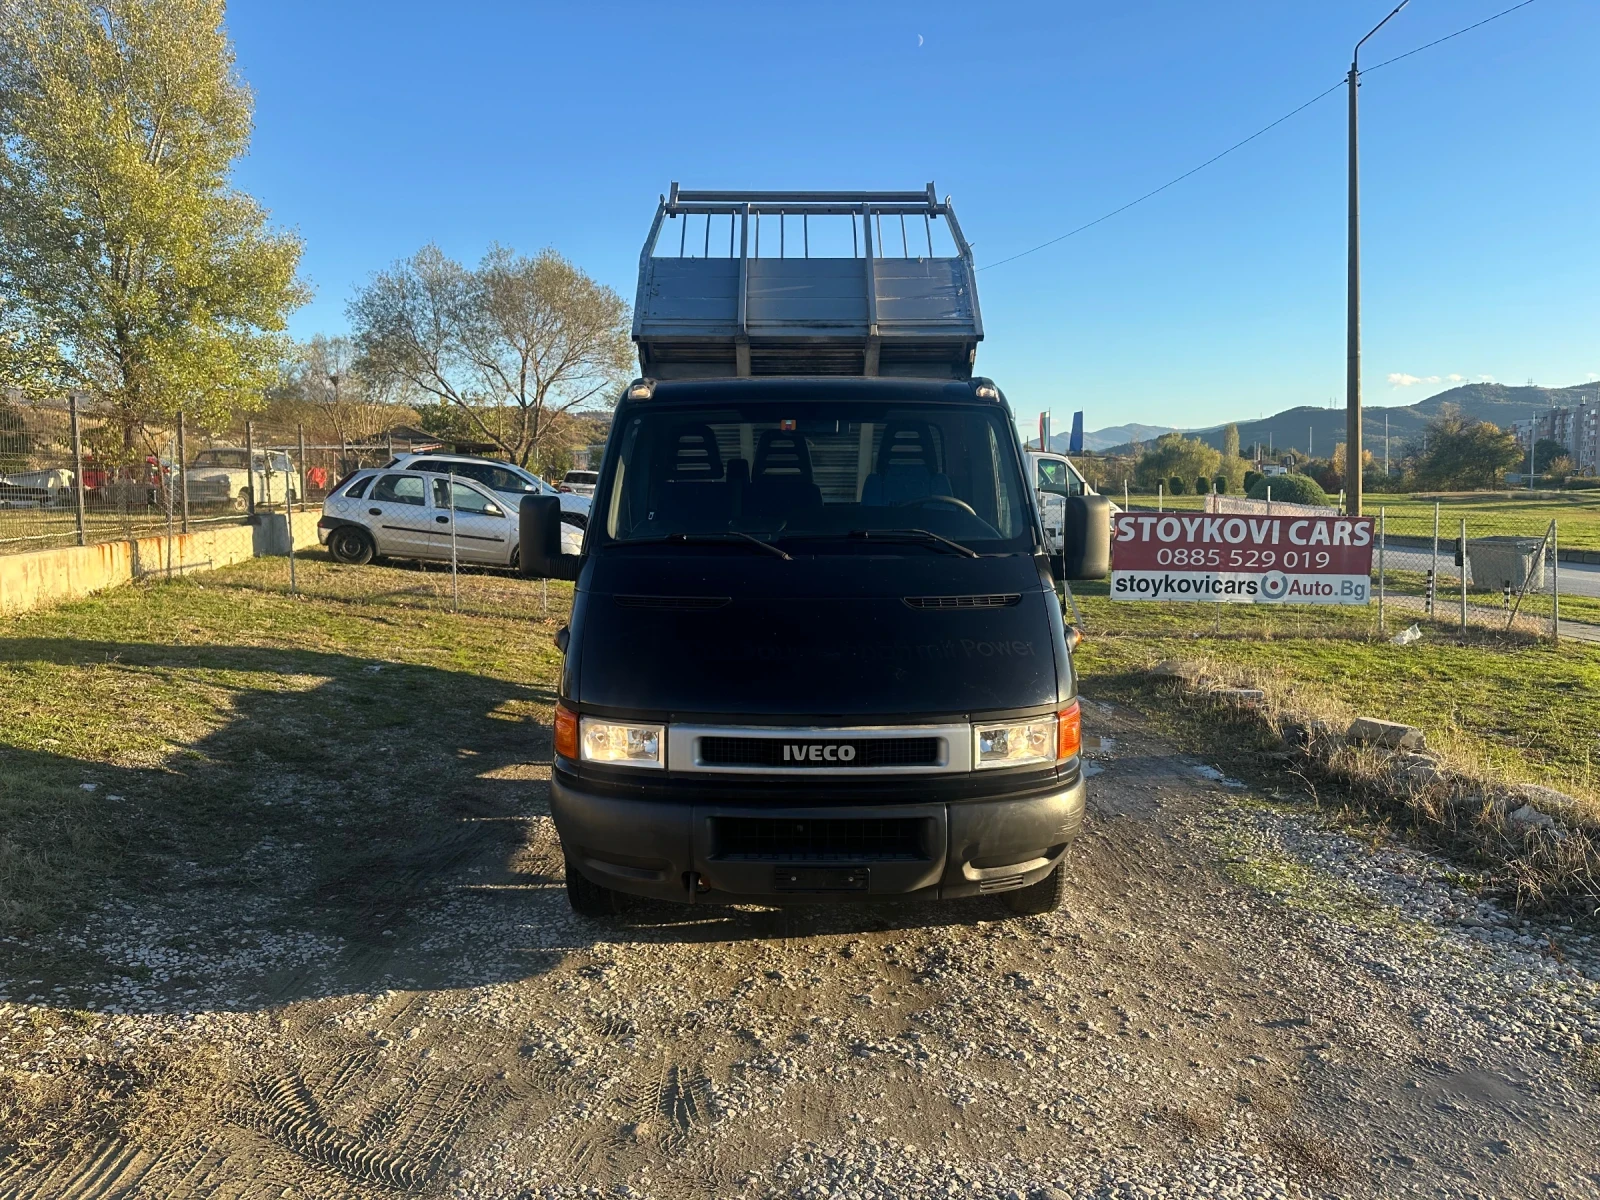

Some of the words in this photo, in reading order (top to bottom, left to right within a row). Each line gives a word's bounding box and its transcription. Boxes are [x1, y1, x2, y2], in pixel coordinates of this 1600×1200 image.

[1116, 516, 1281, 545] STOYKOVI
[1288, 521, 1371, 546] CARS
[1156, 548, 1220, 566] 0885
[1228, 550, 1276, 568] 529
[1283, 551, 1330, 568] 019
[1115, 574, 1258, 597] stoykovicars
[1288, 580, 1366, 600] Auto.Bg
[960, 638, 1037, 658] Power
[783, 744, 856, 761] IVECO
